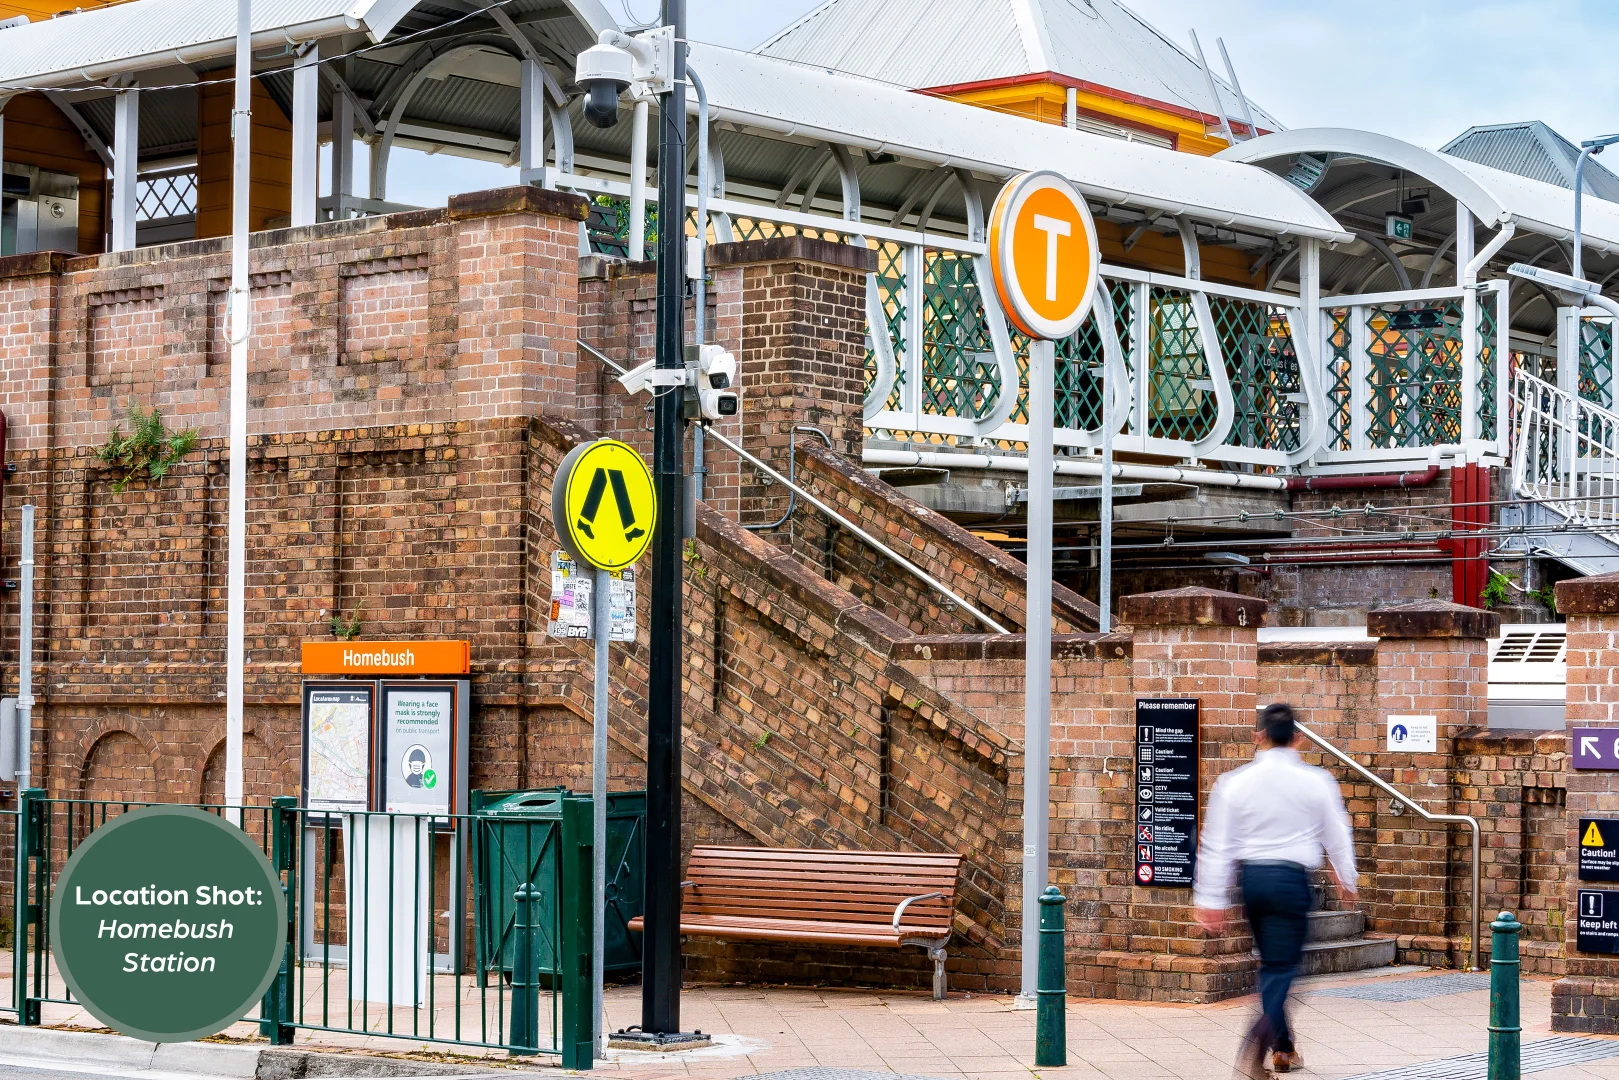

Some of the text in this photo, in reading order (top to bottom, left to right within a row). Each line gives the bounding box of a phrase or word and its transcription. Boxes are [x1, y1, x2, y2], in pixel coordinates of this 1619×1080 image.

[1033, 213, 1072, 302] T
[343, 649, 415, 667] Homebush
[397, 700, 420, 709] Wearing
[426, 700, 439, 708] face
[1138, 701, 1196, 710] Please remember
[411, 709, 416, 717] is
[416, 709, 441, 718] strongly
[397, 718, 439, 726] recommended
[402, 727, 418, 735] public
[418, 727, 440, 735] transport
[1581, 848, 1616, 858] Caution!
[1580, 919, 1618, 930] Keep left
